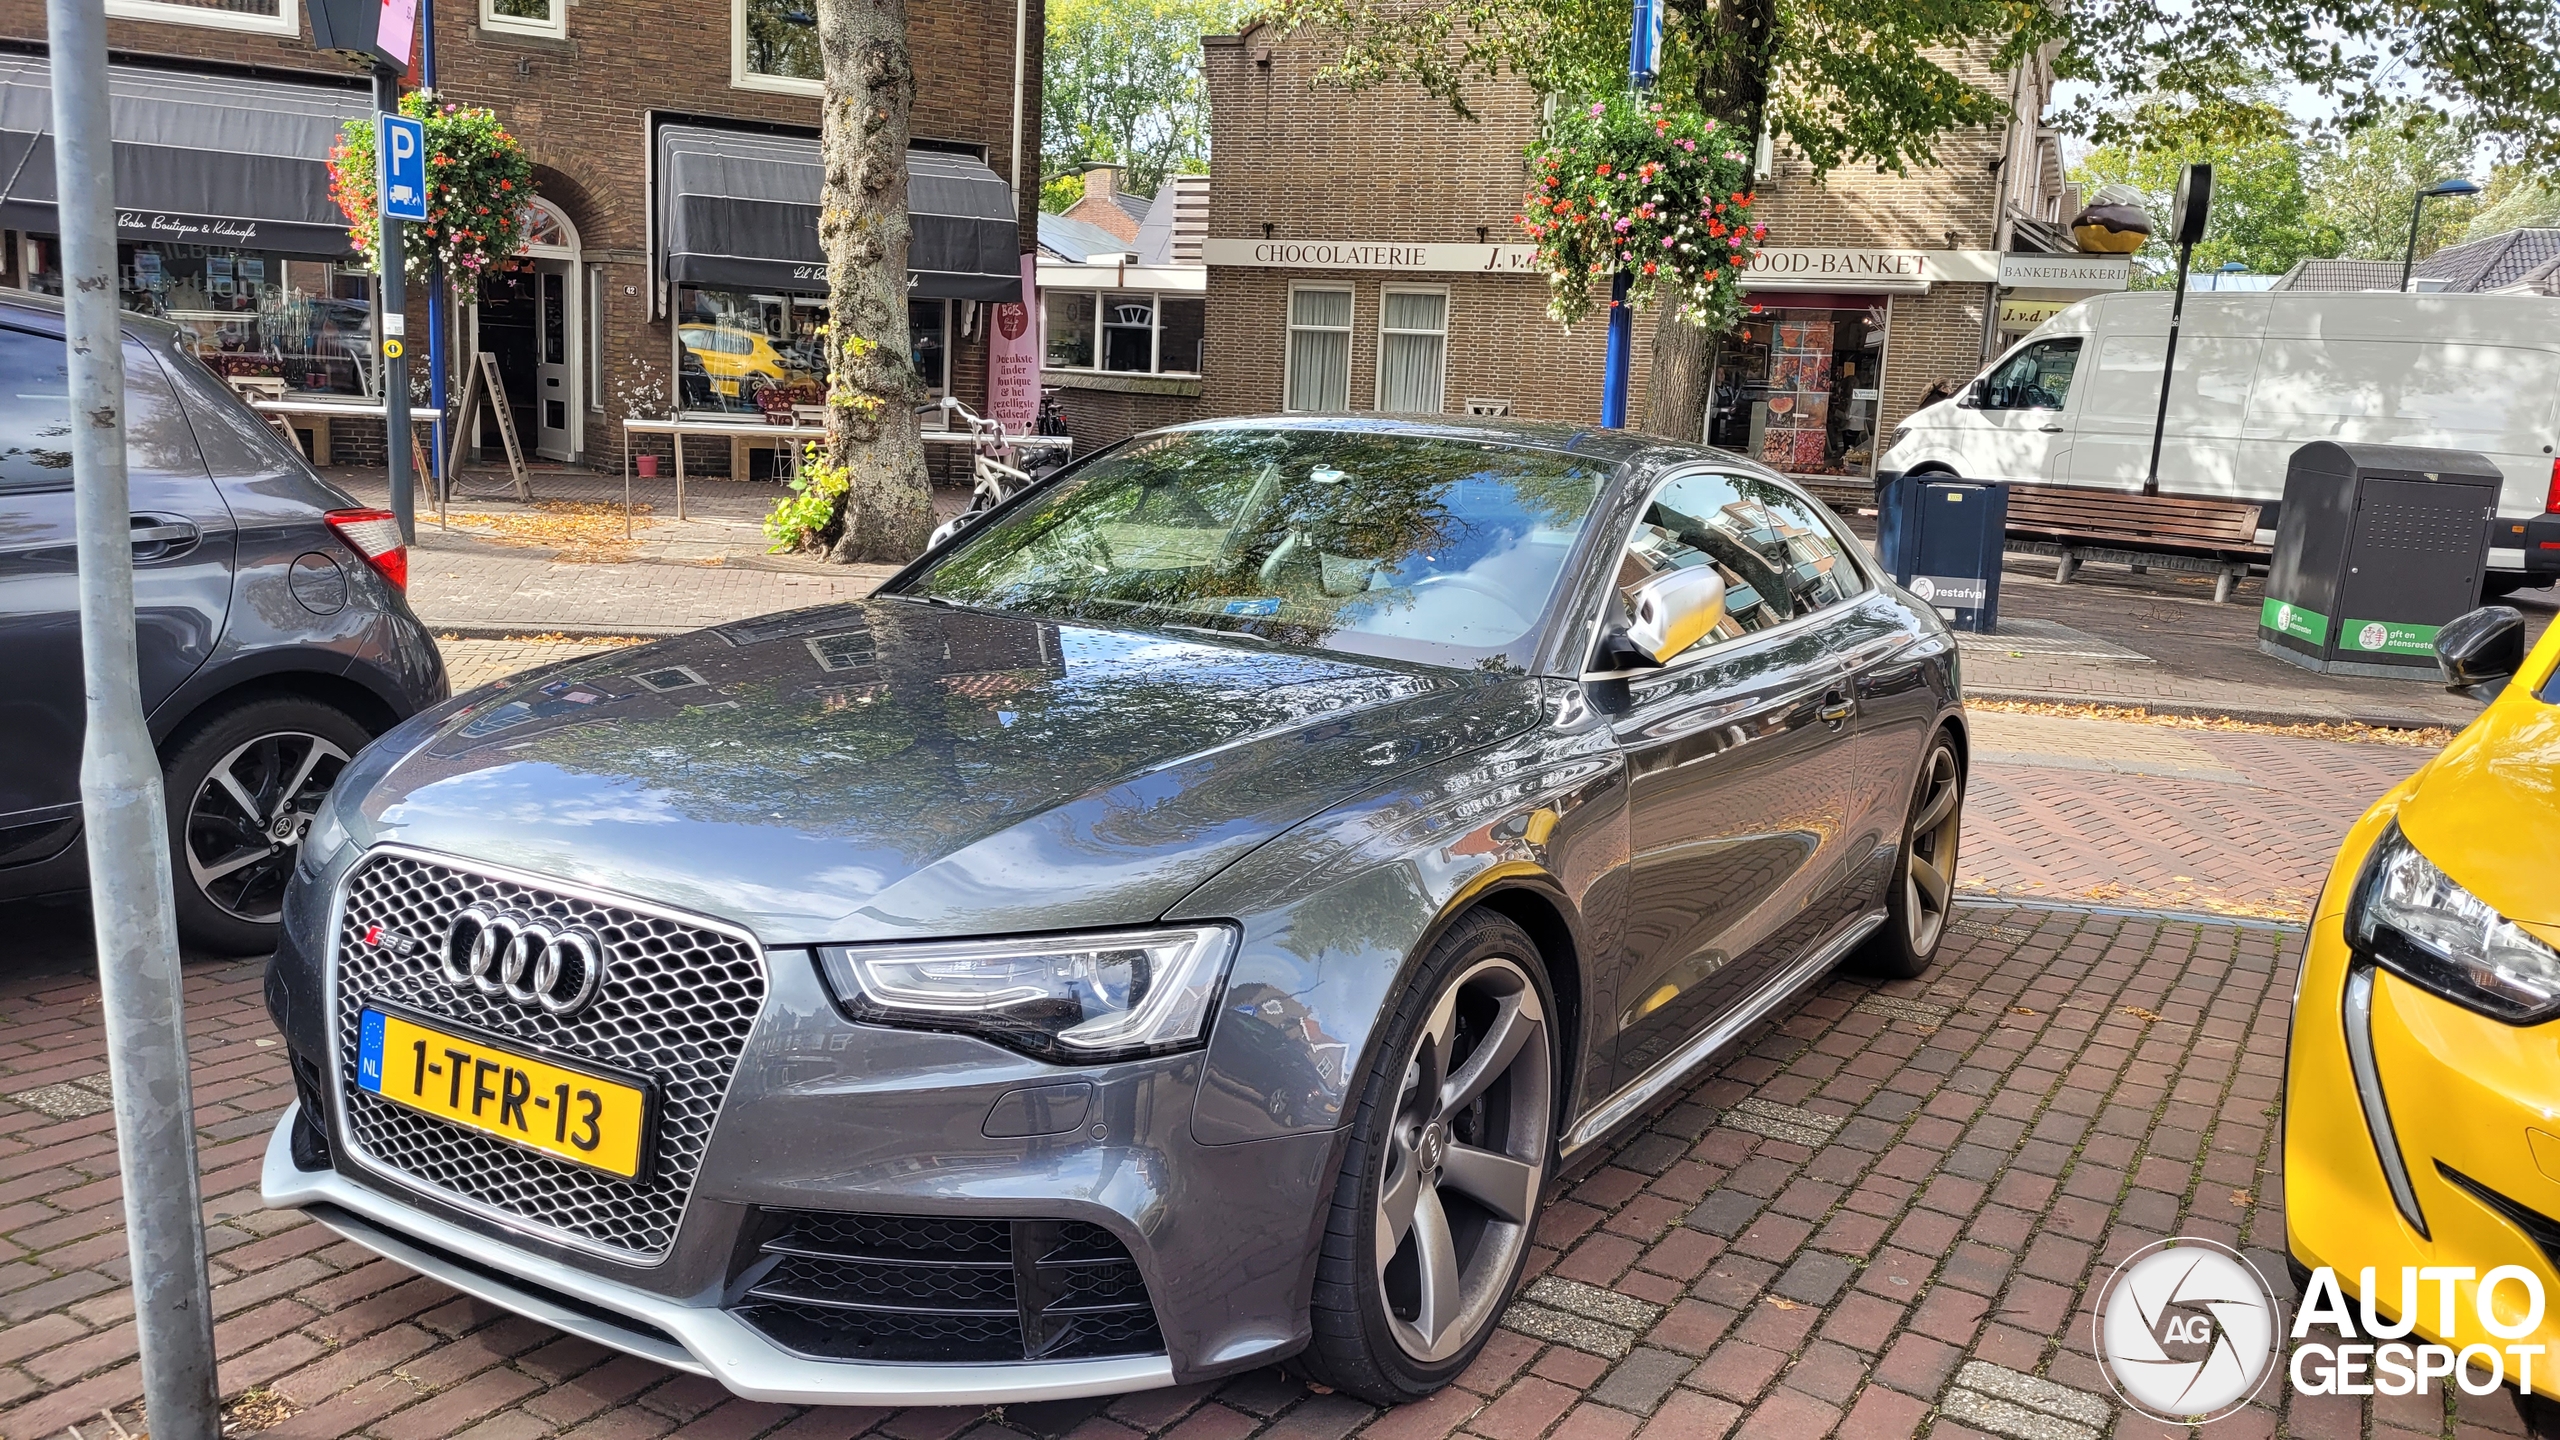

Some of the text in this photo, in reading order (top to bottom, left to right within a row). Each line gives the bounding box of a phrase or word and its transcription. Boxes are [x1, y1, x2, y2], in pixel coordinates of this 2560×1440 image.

[392, 125, 414, 176] P
[118, 213, 256, 244] Bobs Boutique & Kidscafé
[1255, 244, 1427, 266] CHOCOLATERIE
[1484, 247, 1502, 270] J.
[1748, 252, 1931, 275] OOD-BANKET
[2004, 266, 2127, 280] BANKETBAKKERIJ
[626, 286, 635, 295] 42
[1001, 386, 1025, 397] & het
[1936, 587, 1986, 600] restafval
[2388, 640, 2434, 650] etensreste
[2389, 630, 2403, 639] gft
[363, 1057, 379, 1078] NL
[413, 1039, 603, 1152] 1-TFR-13
